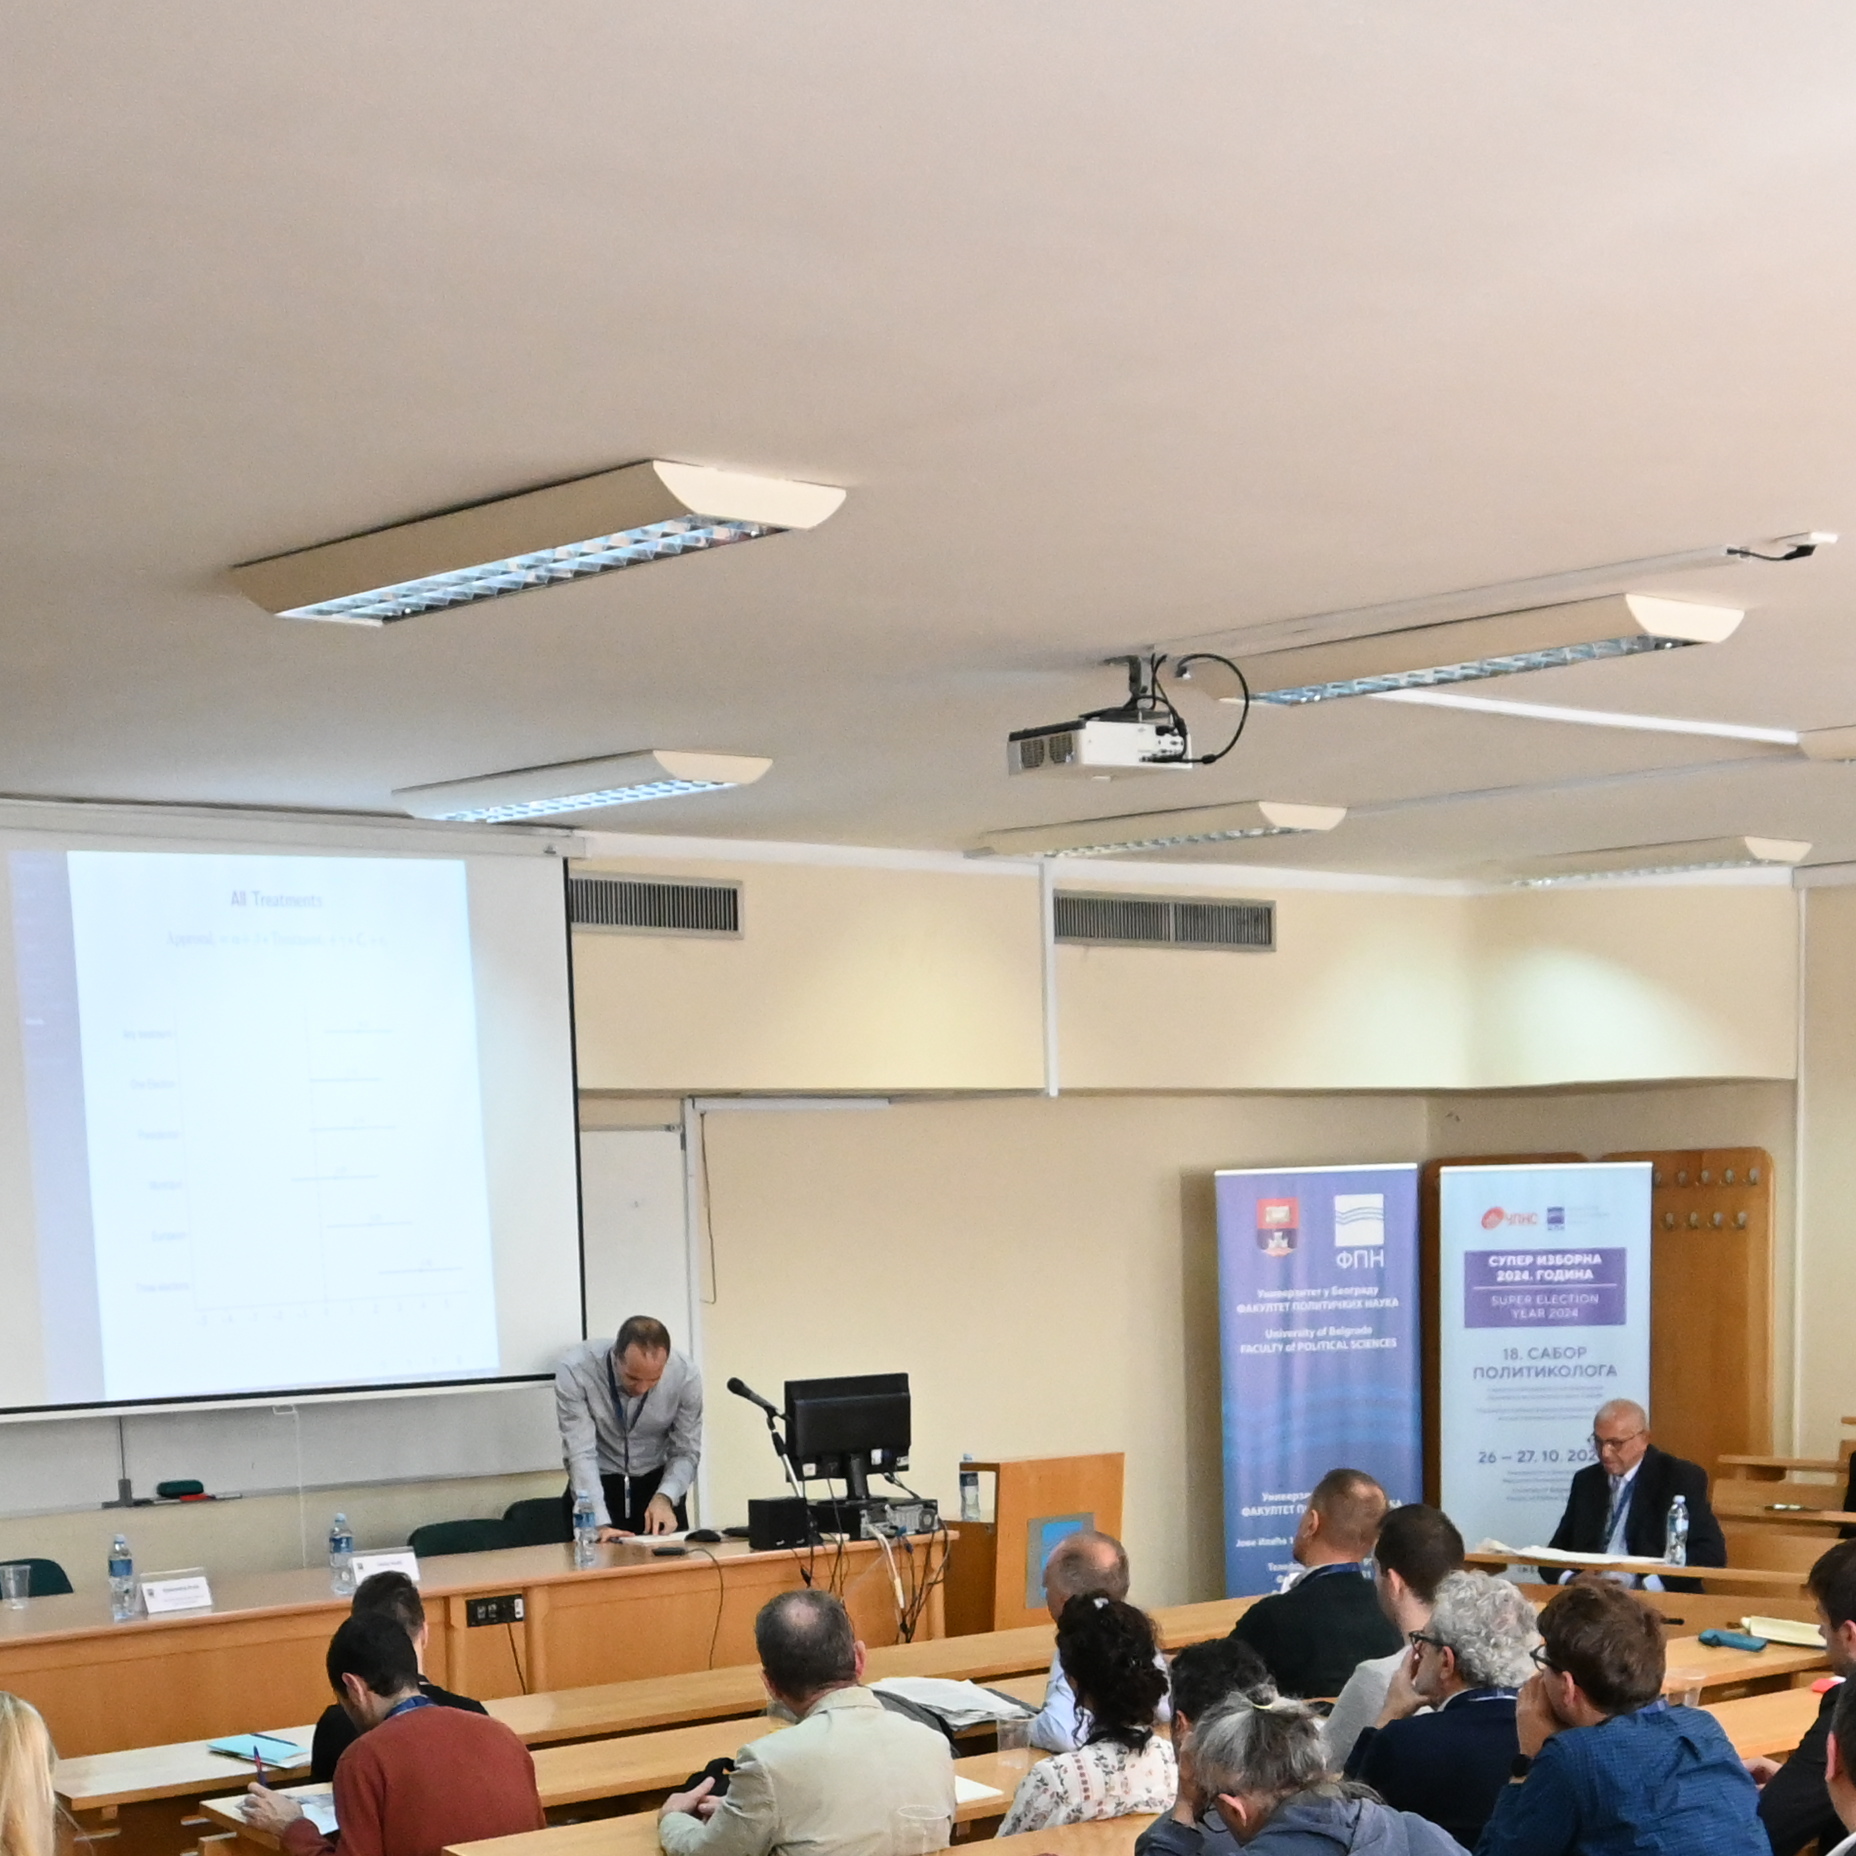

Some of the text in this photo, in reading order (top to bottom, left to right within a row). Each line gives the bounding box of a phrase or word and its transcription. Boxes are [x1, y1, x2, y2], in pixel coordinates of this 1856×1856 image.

[231, 890, 323, 908] All Treatments
[1336, 1248, 1385, 1269] ФПН
[1488, 1253, 1603, 1267] СУПЕР ИЗБОРНА
[1496, 1268, 1594, 1282] 2024. ГОДИНА
[1236, 1301, 1290, 1314] ФАКУЛТЕТ
[1365, 1297, 1400, 1309] НАУКА
[1491, 1293, 1600, 1306] SUPER ELECTION
[1511, 1307, 1580, 1319] YEAR 2024
[1265, 1327, 1315, 1340] University
[1240, 1342, 1283, 1354] FACULTY
[1297, 1339, 1349, 1352] POLITICAL
[1350, 1337, 1397, 1350] SCIENCES
[1502, 1346, 1587, 1361] 18. САБОР
[1473, 1364, 1618, 1380] ПОЛИТИКОЛОГА
[1478, 1451, 1497, 1464] 26
[1517, 1450, 1537, 1463] 27.
[1567, 1450, 1596, 1463] 202
[1241, 1506, 1294, 1517] ФАКУЛТЕТ
